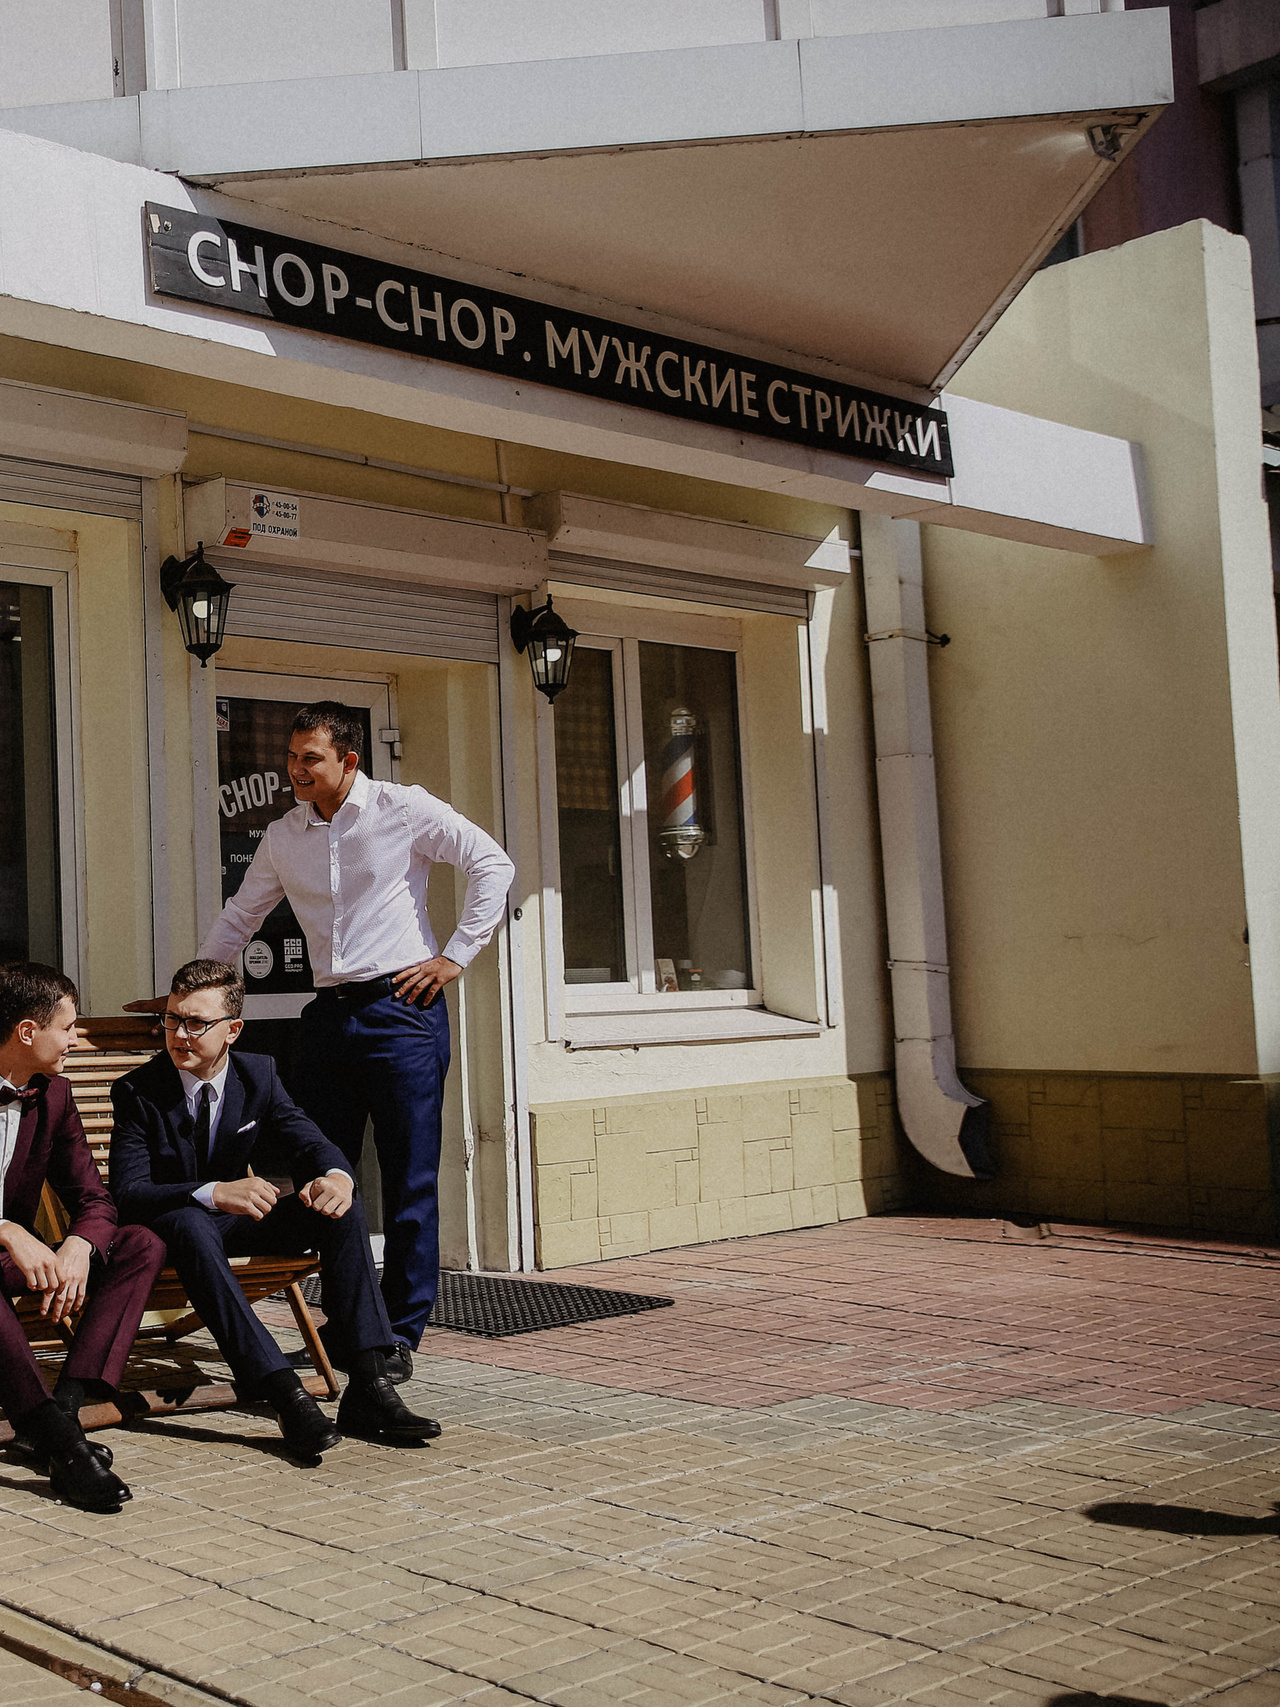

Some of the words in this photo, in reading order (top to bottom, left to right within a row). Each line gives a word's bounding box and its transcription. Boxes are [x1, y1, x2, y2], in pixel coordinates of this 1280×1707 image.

[545, 320, 760, 418] МУЖСКИЕ
[767, 379, 942, 461] СТРИЖКИ
[252, 523, 266, 533] ПОД
[268, 525, 298, 537] ОХРАНОЙ
